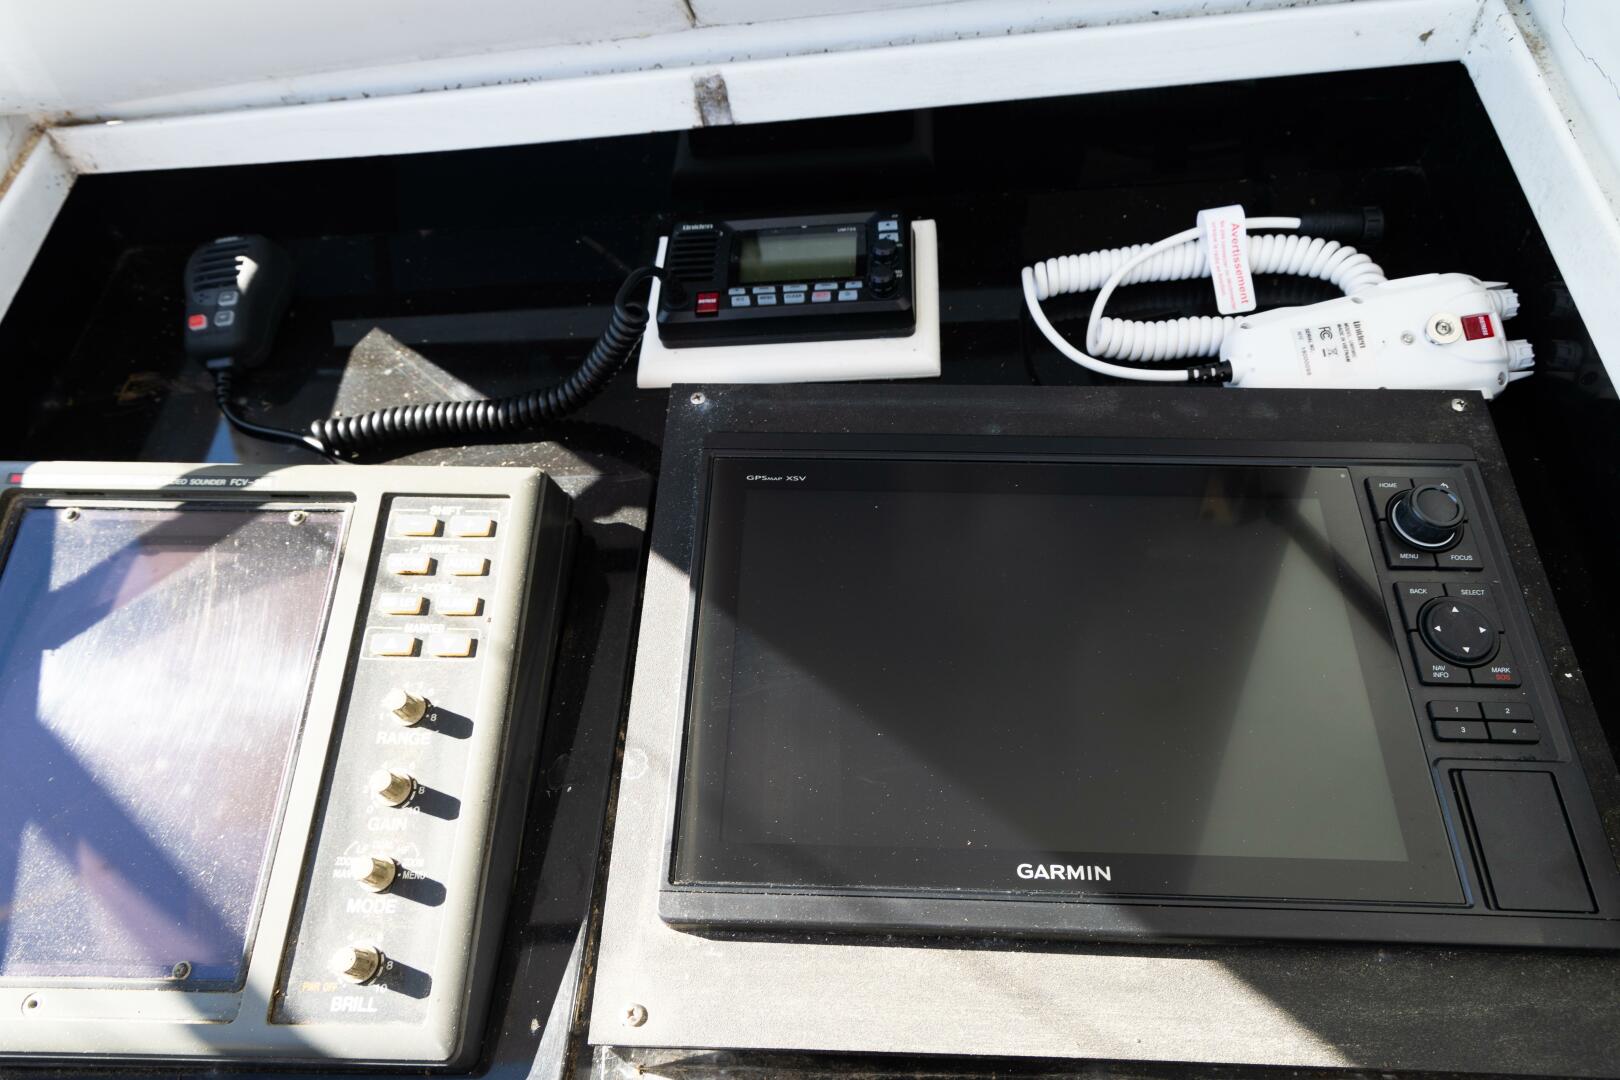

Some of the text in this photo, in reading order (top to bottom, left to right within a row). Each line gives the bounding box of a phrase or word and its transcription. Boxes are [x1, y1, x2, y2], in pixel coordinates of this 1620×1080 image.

[1231, 223, 1249, 304] Avertissement
[189, 478, 227, 486] SOUNDER
[429, 505, 463, 516] SHIFT
[430, 714, 437, 722] 8
[375, 731, 432, 746] RANGE
[418, 786, 425, 795] 8
[367, 816, 408, 831] GAIN
[402, 870, 426, 880] MENU
[1016, 863, 1112, 881] GARMIN
[346, 899, 397, 914] MODE
[386, 961, 394, 970] 8
[330, 996, 379, 1013] BRILL
